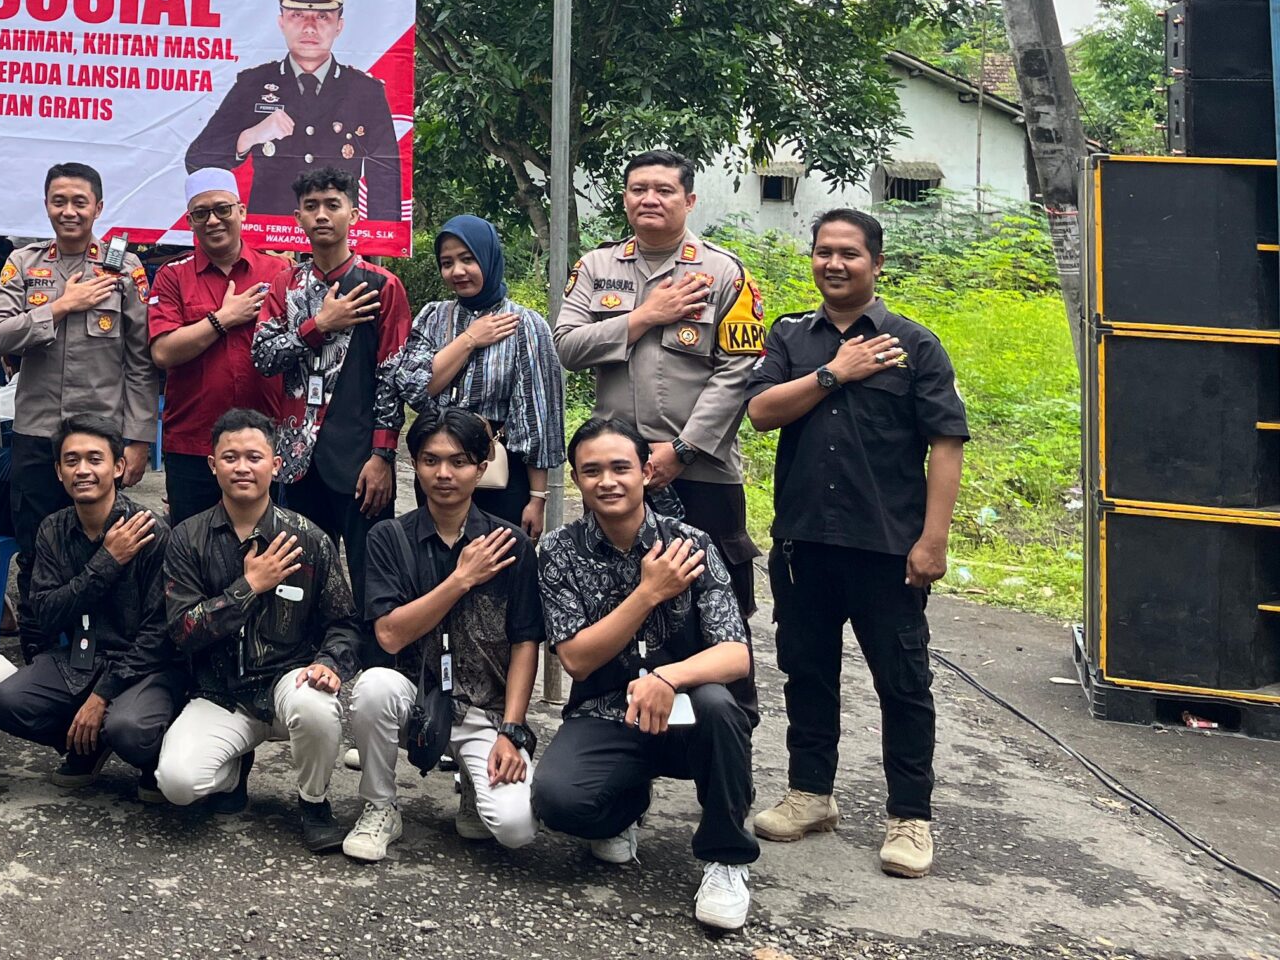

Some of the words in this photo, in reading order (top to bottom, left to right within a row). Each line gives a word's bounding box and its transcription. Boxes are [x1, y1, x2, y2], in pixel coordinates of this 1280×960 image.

[83, 32, 158, 57] KHITAN
[164, 35, 239, 64] MASAL,
[67, 64, 141, 90] LANSIA
[146, 68, 213, 92] DUAFA
[38, 95, 113, 121] GRATIS
[266, 225, 292, 233] FERRY
